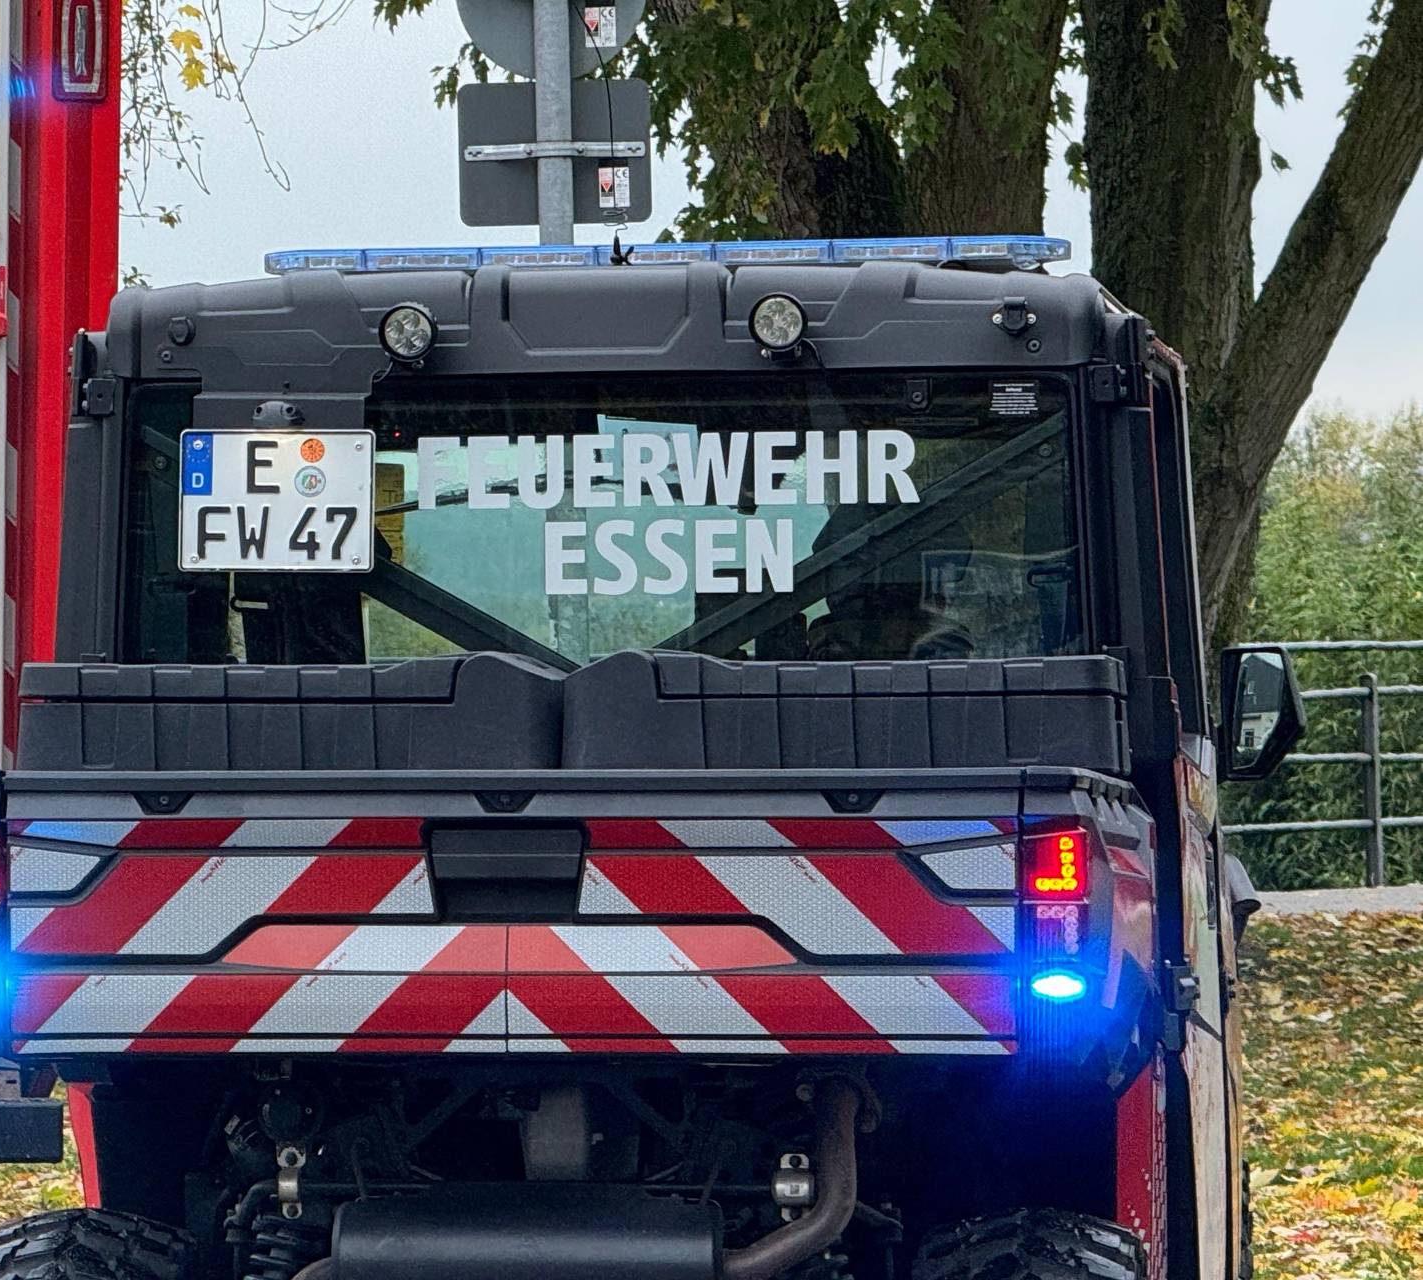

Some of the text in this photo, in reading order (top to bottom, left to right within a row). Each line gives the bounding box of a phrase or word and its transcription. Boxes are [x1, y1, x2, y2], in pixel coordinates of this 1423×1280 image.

[192, 473, 204, 488] D
[247, 441, 280, 494] E
[417, 430, 921, 510] FEUERWEHR
[197, 506, 358, 560] FW 47
[545, 519, 794, 596] ESSEN
